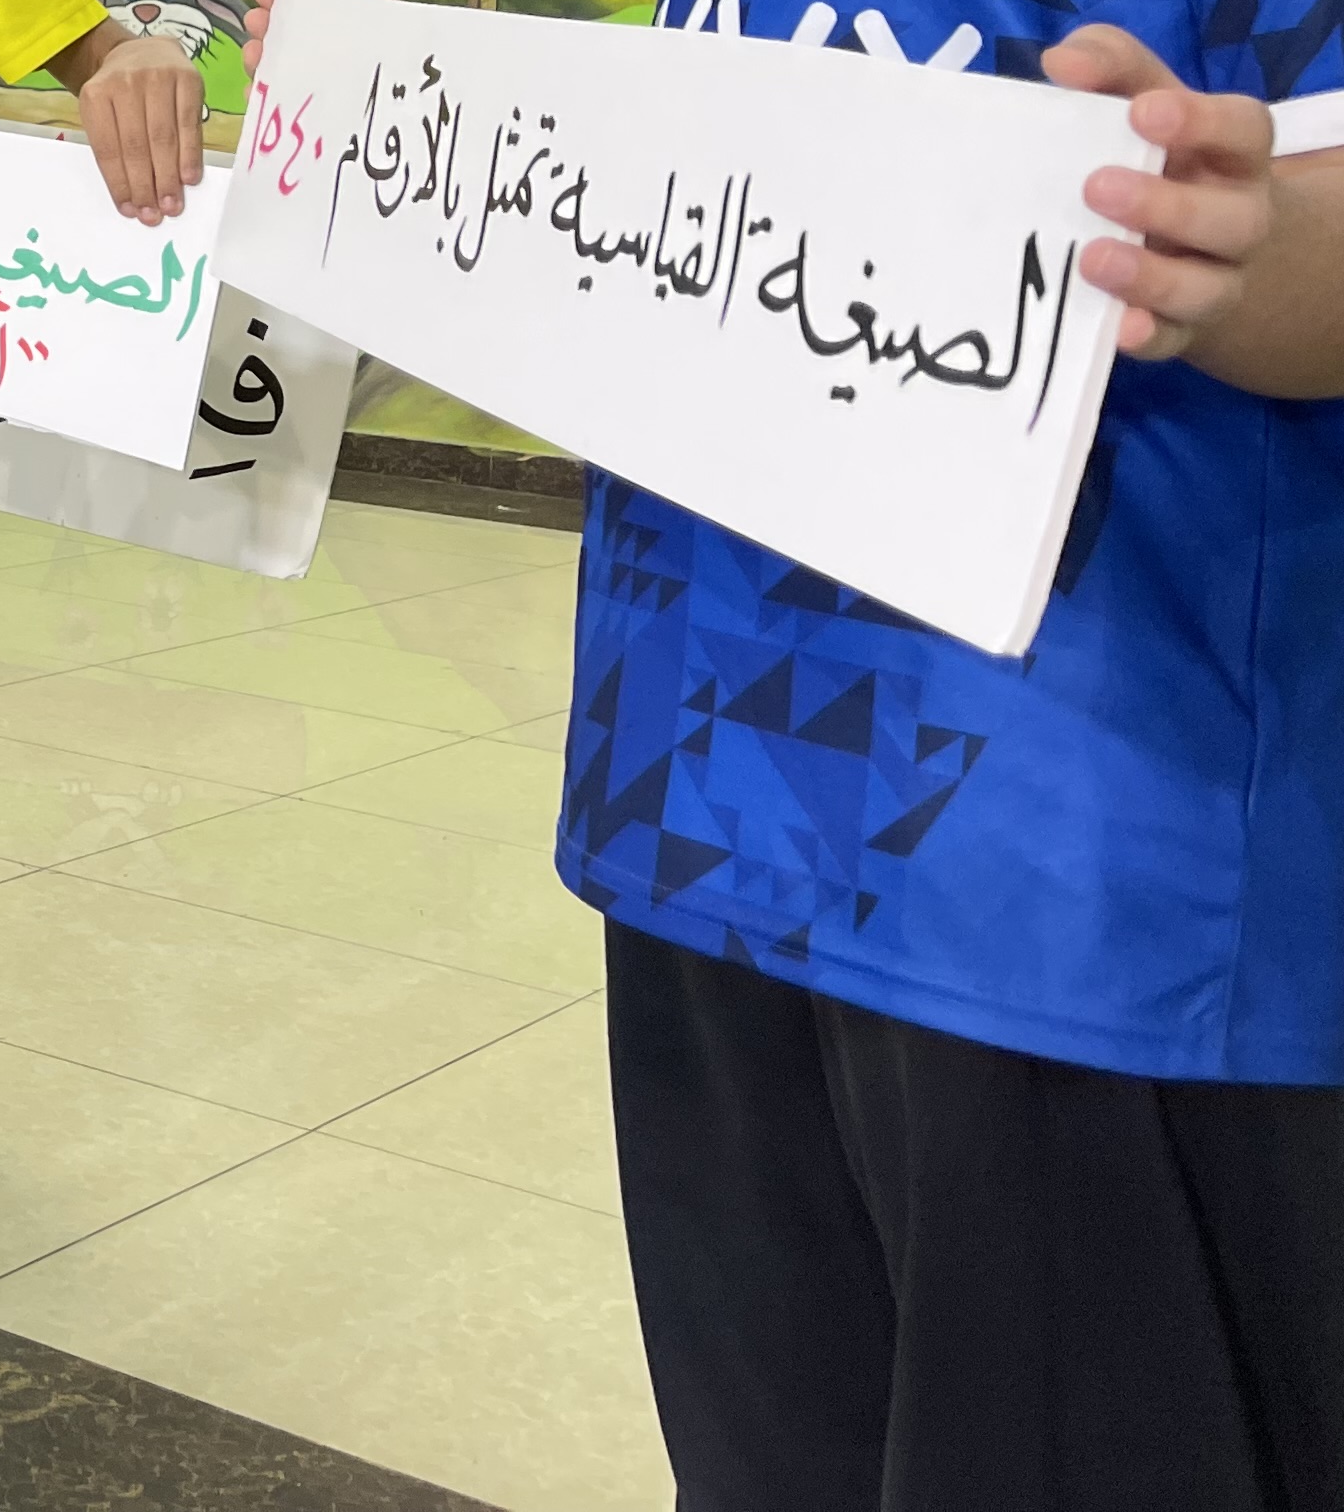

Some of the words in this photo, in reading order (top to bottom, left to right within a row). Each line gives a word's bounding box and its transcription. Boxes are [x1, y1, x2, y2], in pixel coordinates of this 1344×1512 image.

[322, 54, 462, 269] بالأرقام
[454, 106, 556, 272] تمثل
[551, 162, 752, 327] القياسية
[748, 217, 1076, 433] الصيغة
